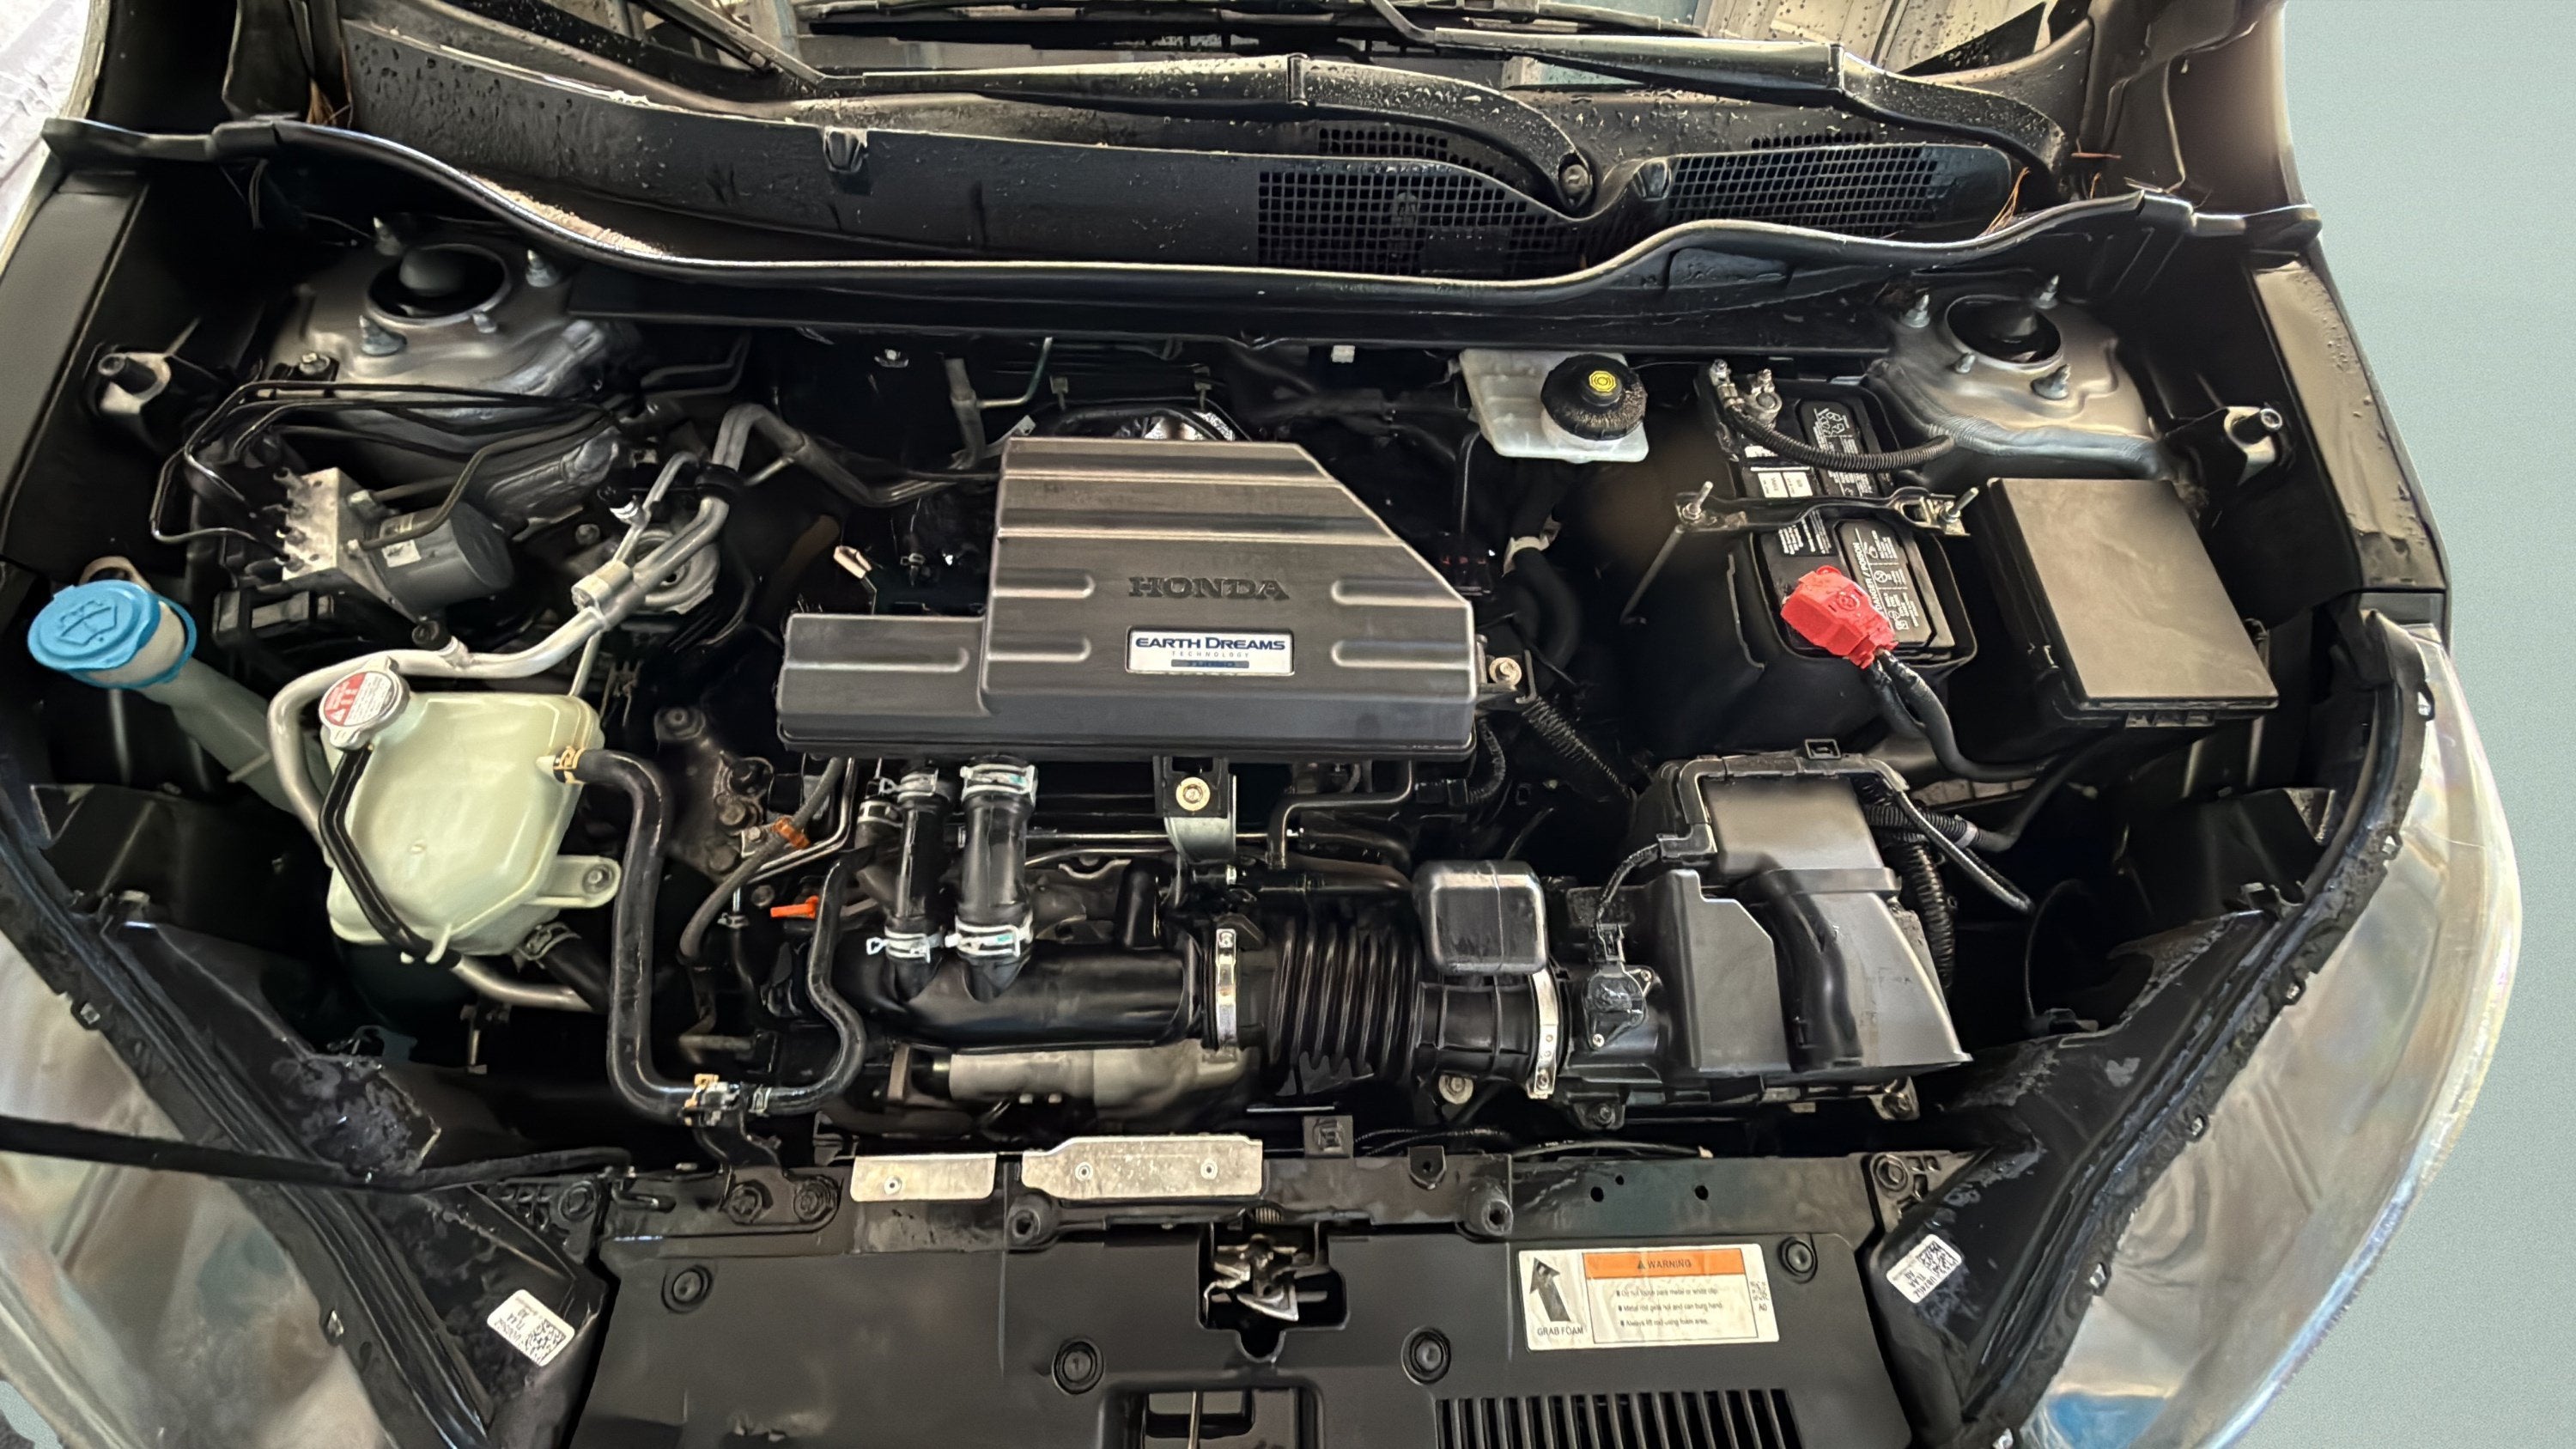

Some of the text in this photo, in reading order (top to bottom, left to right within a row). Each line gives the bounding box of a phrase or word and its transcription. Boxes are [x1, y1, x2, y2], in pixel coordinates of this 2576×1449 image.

[1852, 542, 1868, 575] POISON
[1128, 576, 1290, 600] HONDA
[1865, 577, 1882, 615] DANGER
[1135, 637, 1285, 650] EARTH DREAMS
[1648, 1258, 1692, 1269] WARNING
[1537, 1325, 1584, 1336] GRAB FOAM
